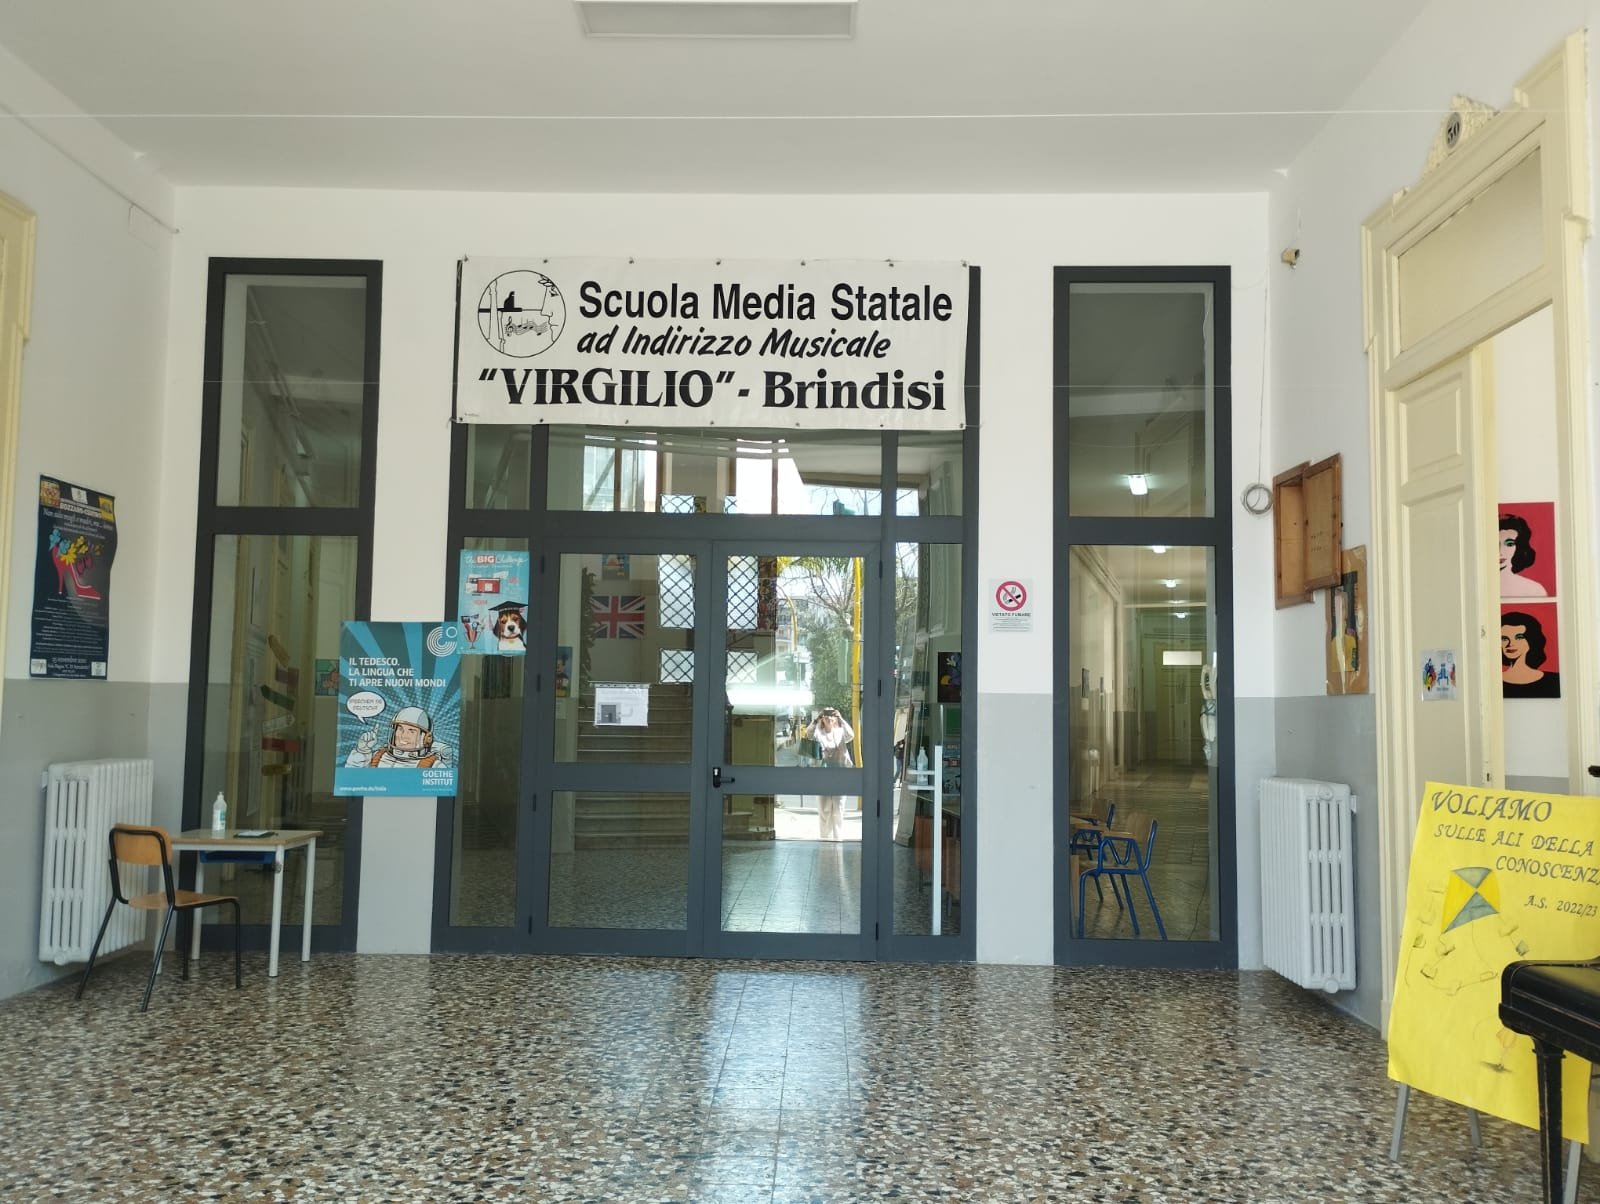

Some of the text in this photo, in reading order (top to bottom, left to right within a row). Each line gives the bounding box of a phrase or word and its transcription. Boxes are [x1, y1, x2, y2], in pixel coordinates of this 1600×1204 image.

[579, 281, 953, 322] Scuola Media Statale
[577, 324, 892, 358] ad Indirizzo Musicale
[762, 368, 947, 411] Brindisi
[476, 555, 496, 564] BIG
[348, 667, 414, 677] LA LINGUA CHE
[349, 657, 400, 666] IL TEDESCO.
[349, 678, 446, 687] TI APRE NUOVI MONDI
[422, 770, 454, 778] GOETHE
[422, 778, 454, 786] INSTITUT
[1431, 790, 1552, 822] VOLIAMO
[1434, 824, 1595, 857] SULLE ALI DELLA
[1496, 855, 1600, 886] CONOSCENZ
[1524, 895, 1598, 917] A.S. 2022/23
